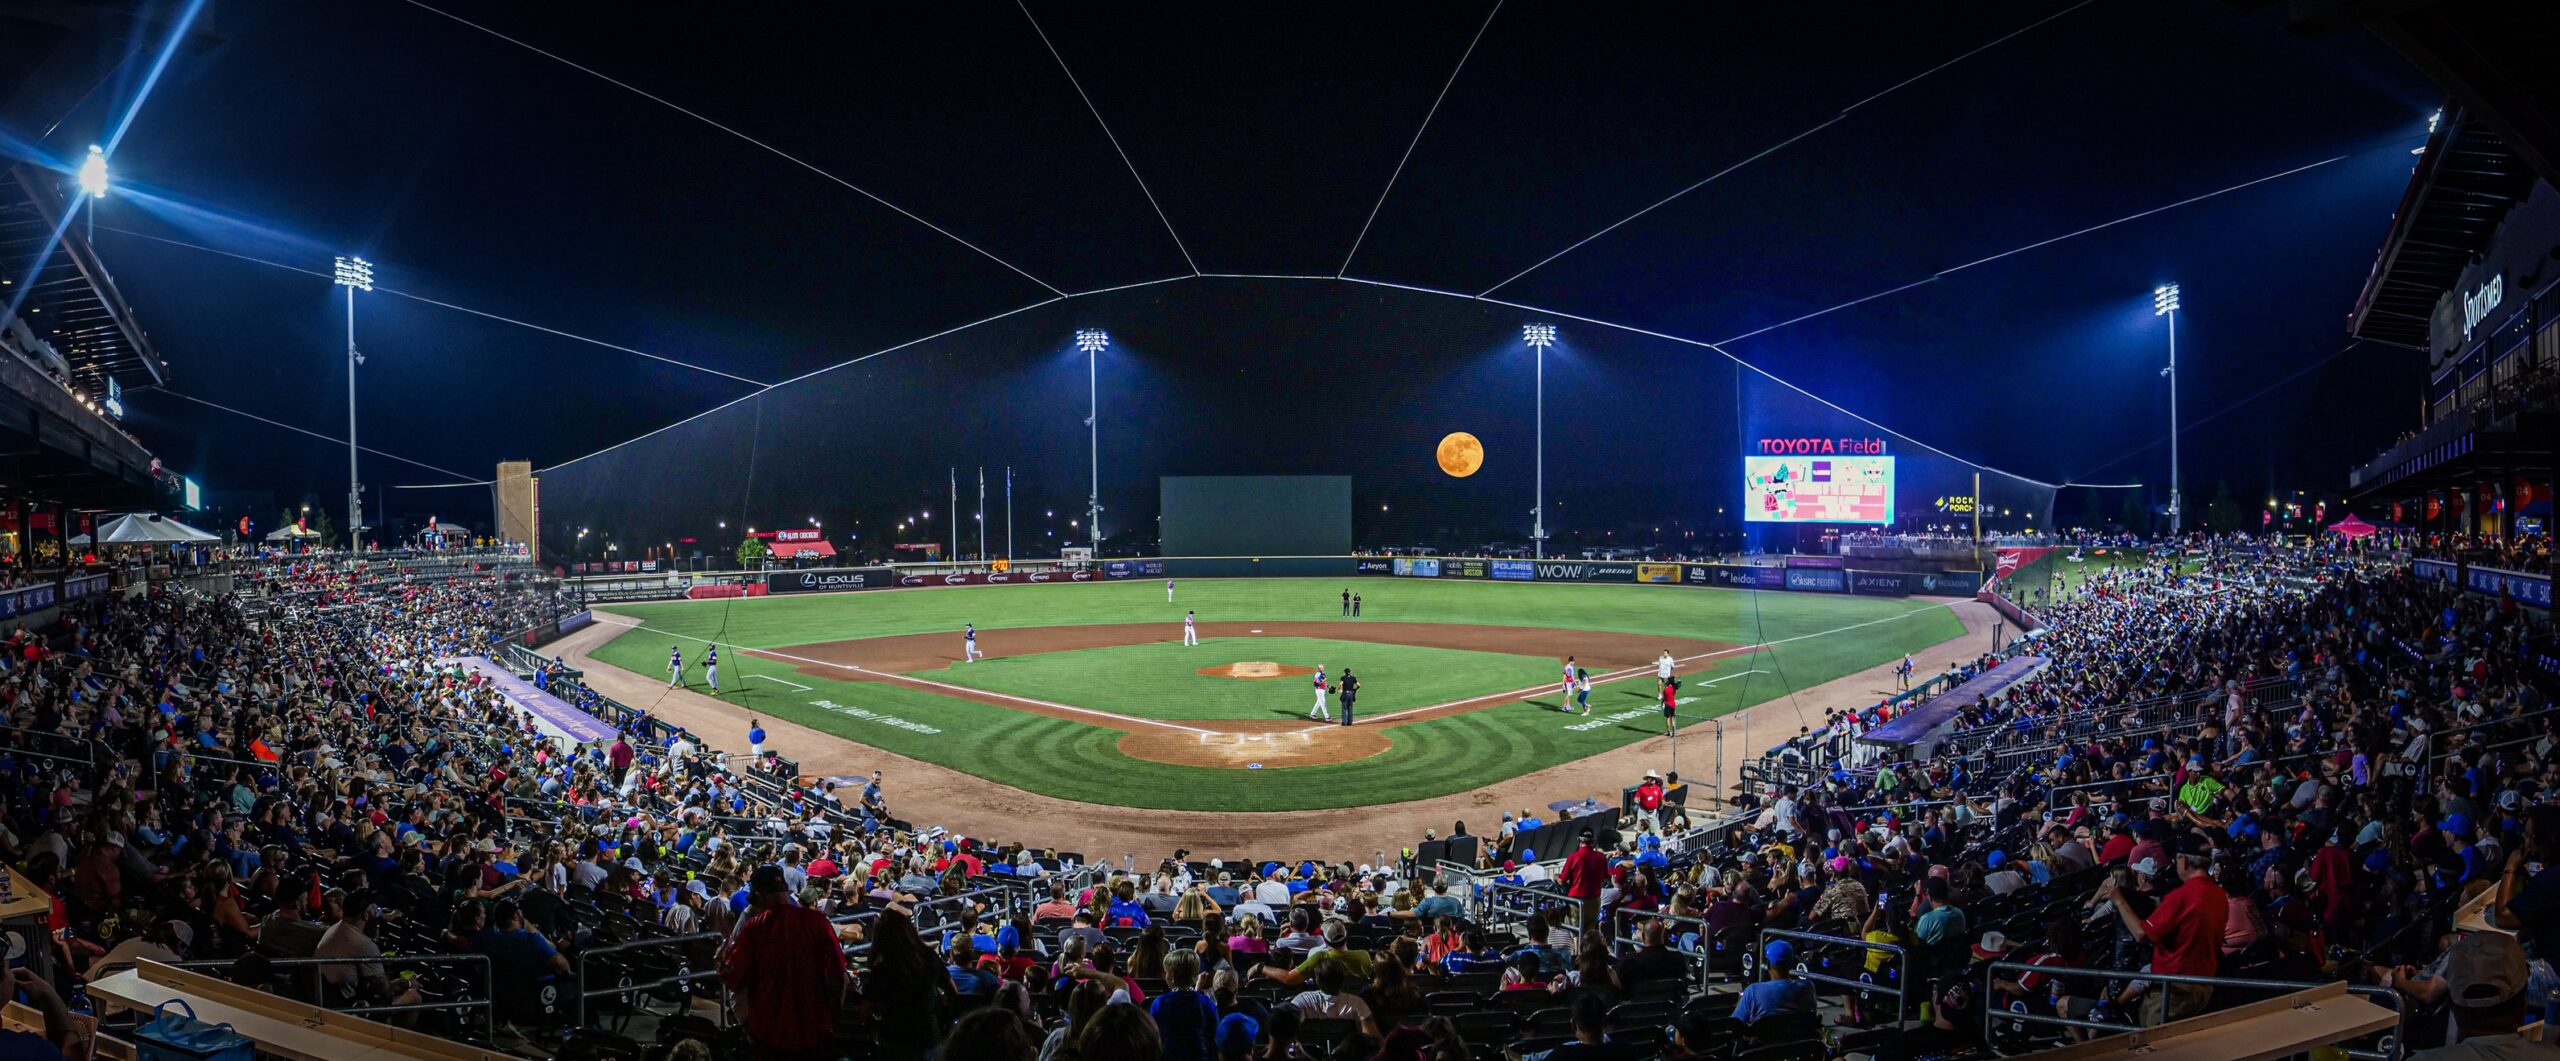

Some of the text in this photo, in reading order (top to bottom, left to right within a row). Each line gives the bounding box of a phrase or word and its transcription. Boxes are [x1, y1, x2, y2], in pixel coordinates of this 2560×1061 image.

[1761, 437, 1880, 454] TOYOTA Field
[1949, 496, 1974, 504] ROCK
[7, 511, 18, 520] 12
[992, 560, 1008, 571] 2:00
[1366, 562, 1387, 570] Aeyon
[1493, 562, 1532, 571] POLARIS
[1537, 564, 1582, 579] WOW!
[1691, 567, 1705, 577] Alfa
[818, 574, 864, 584] LEXUS
[1730, 573, 1756, 585] leidos
[1799, 577, 1817, 586] ASRC
[1858, 577, 1902, 588] AXIENT
